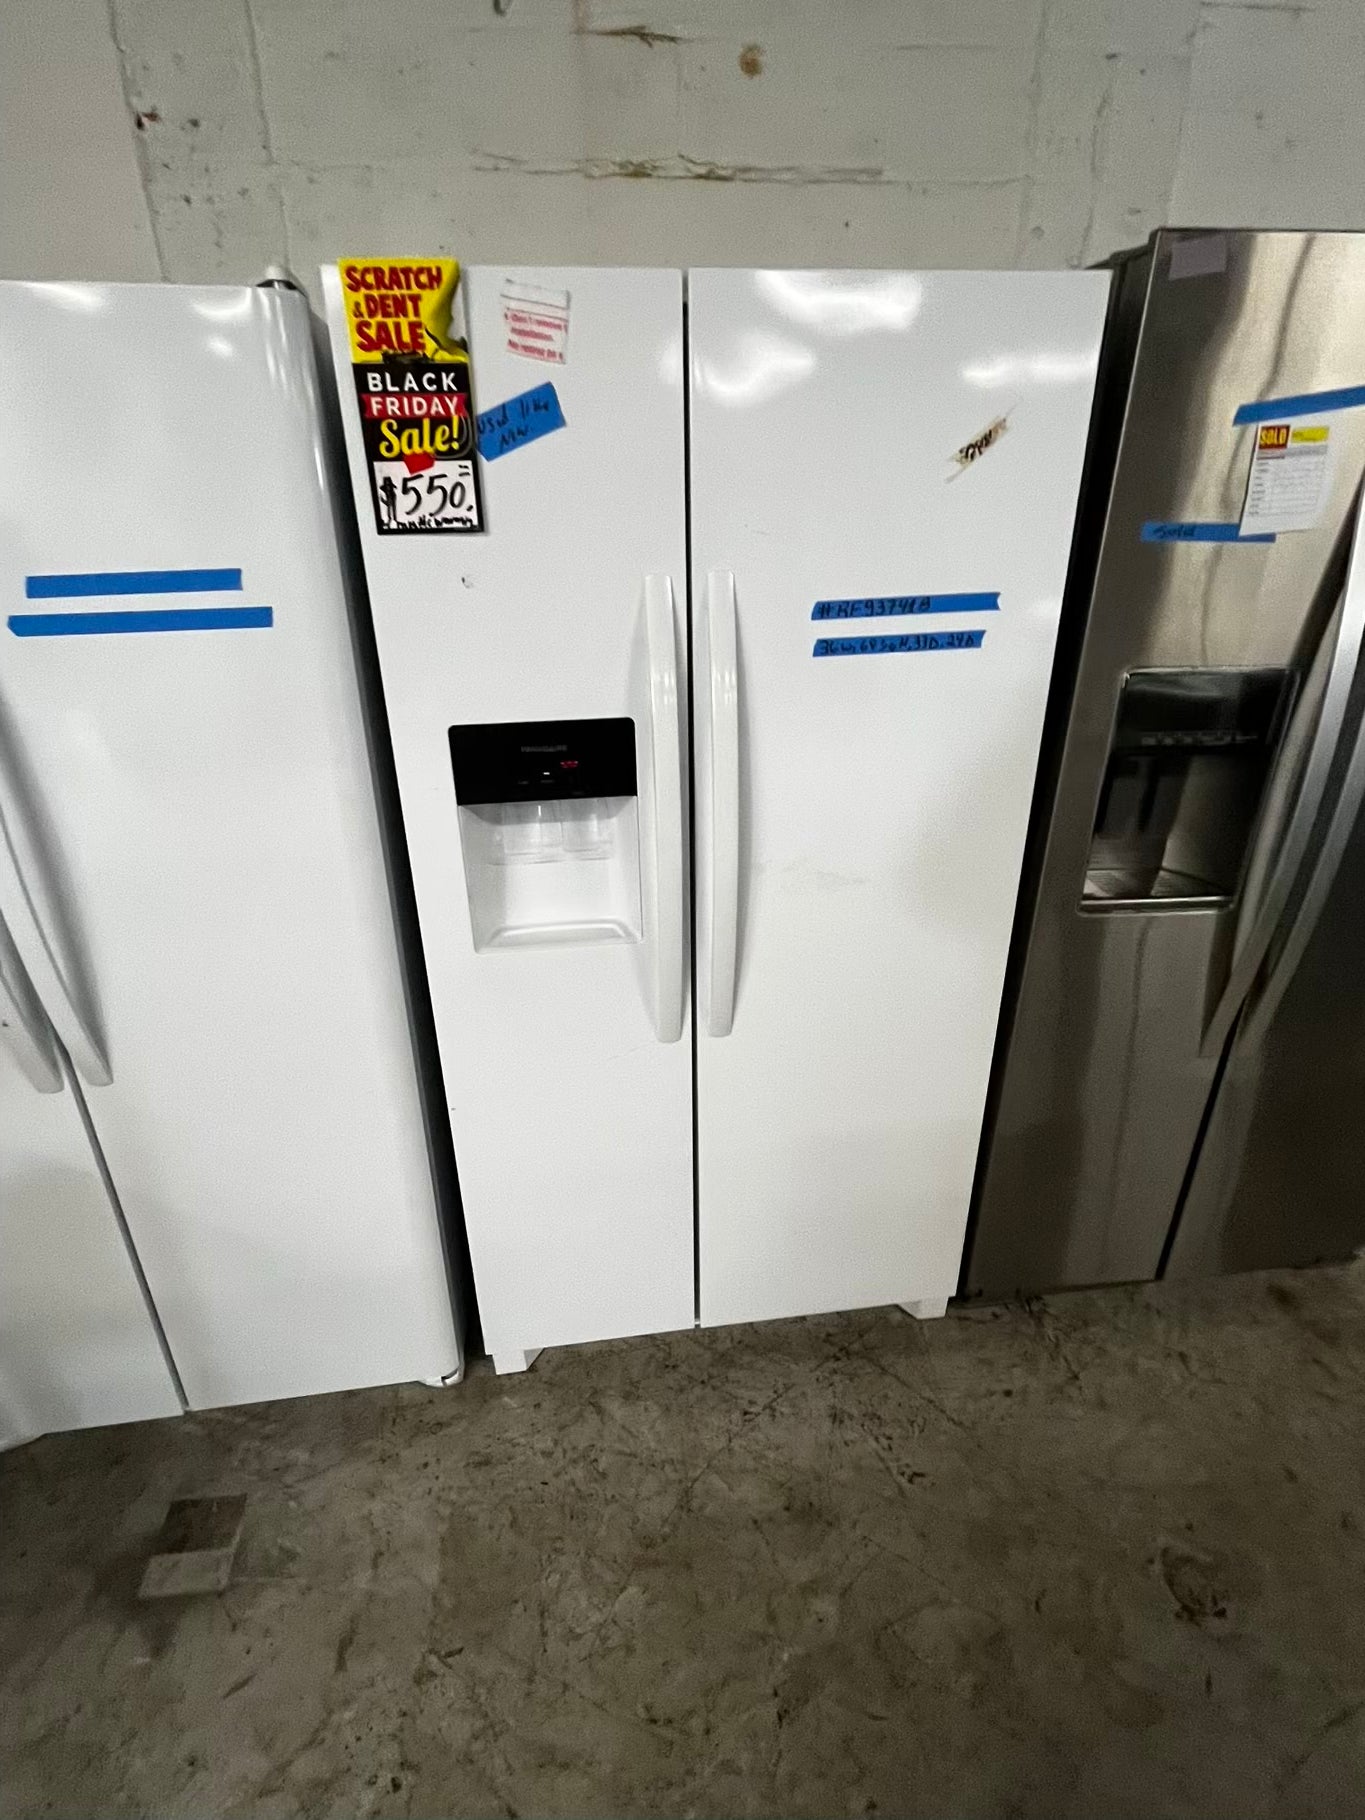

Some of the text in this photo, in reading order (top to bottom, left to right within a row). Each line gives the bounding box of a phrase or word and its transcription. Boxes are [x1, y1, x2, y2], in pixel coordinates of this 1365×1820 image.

[345, 265, 443, 292] SCRATCH
[353, 293, 422, 319] & DENT
[356, 320, 426, 353] SALE
[367, 372, 458, 392] BLACK
[370, 395, 459, 416] FRIDAY
[379, 414, 460, 458] Sale!
[1260, 428, 1288, 447] SOLD
